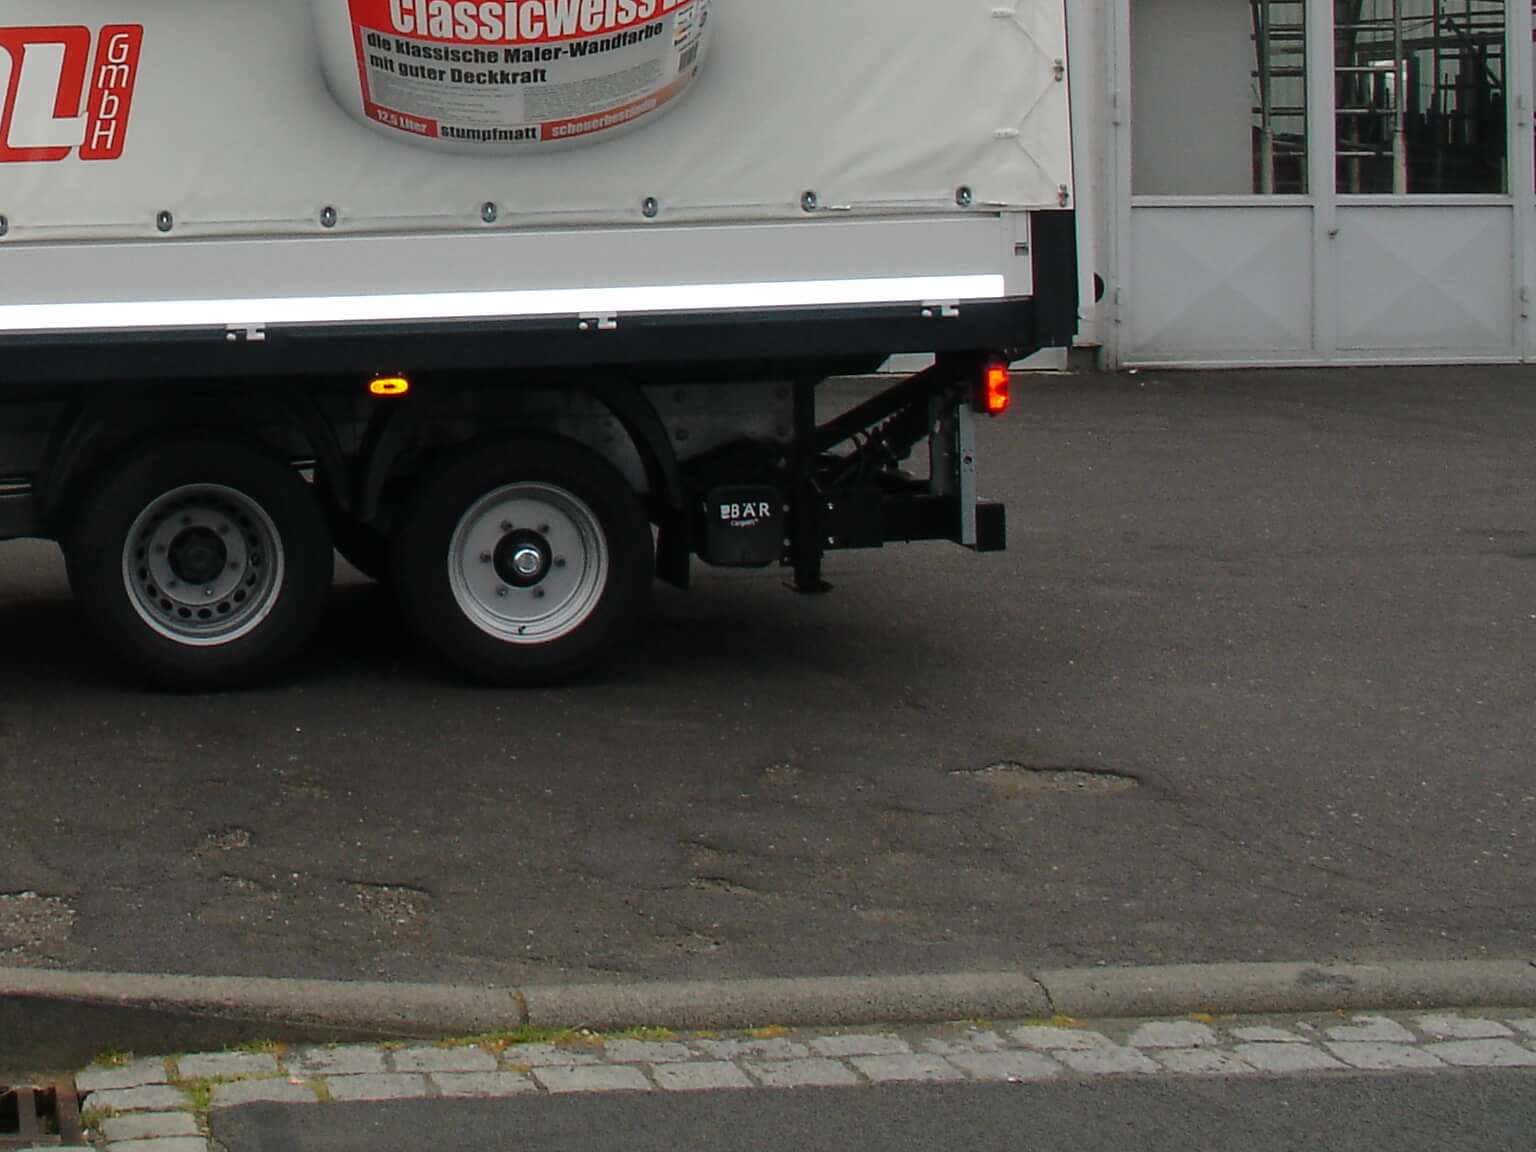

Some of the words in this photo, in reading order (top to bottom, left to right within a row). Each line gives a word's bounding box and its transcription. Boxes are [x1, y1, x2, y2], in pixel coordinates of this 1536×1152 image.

[367, 32, 391, 51] die
[395, 39, 499, 64] klassische
[504, 22, 663, 64] Maler-Wandfarbe
[370, 53, 394, 72] mit
[399, 62, 446, 83] guter
[450, 68, 547, 85] Deckkraft
[91, 33, 129, 150] GmbH
[440, 125, 537, 141] stumpfmatt
[731, 501, 771, 518] BÄR
